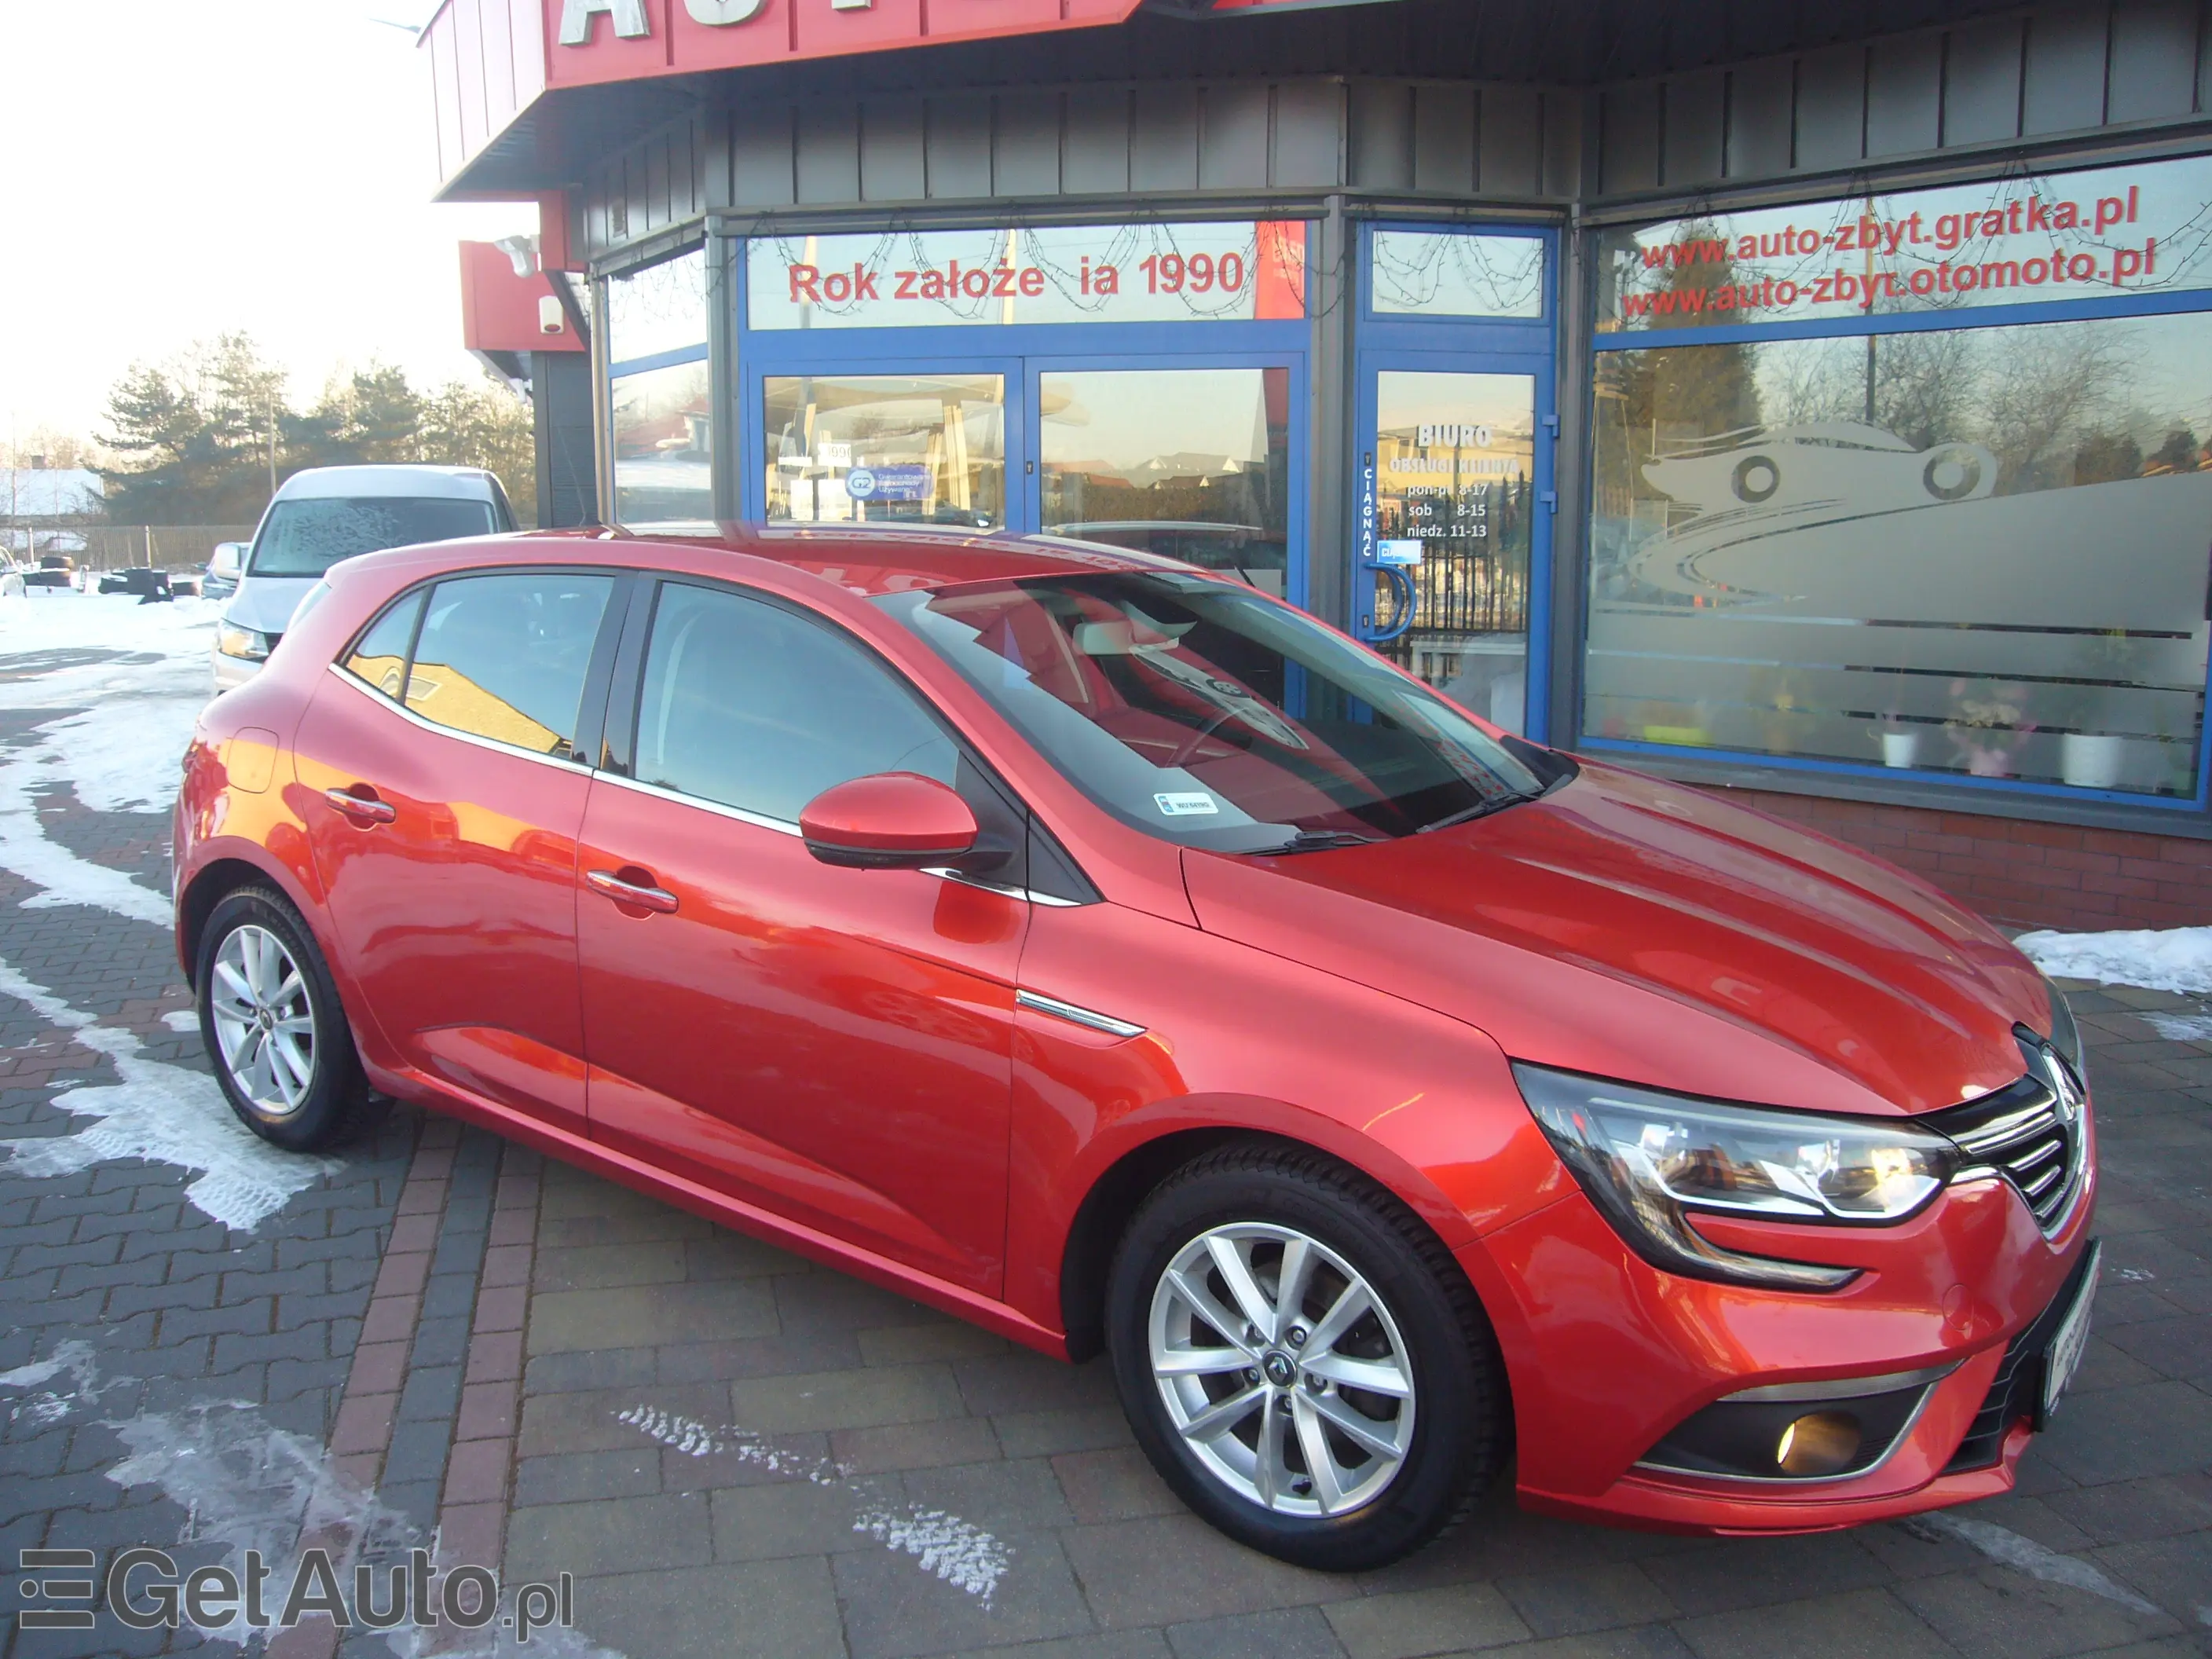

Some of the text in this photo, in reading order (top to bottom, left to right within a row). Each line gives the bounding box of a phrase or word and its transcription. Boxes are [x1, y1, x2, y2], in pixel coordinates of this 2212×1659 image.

[1641, 185, 2139, 269] www.auto-zbyt.gratka.pl
[789, 262, 879, 303] Rok
[1139, 251, 1244, 295] 1990
[1622, 238, 2157, 317] www.auto-zbyt.otomoto.pl
[1417, 424, 1493, 449] BIURO
[1459, 484, 1489, 496] 8-17
[1408, 503, 1486, 517] sob 8-15
[1407, 524, 1487, 537] niedz. 11-13
